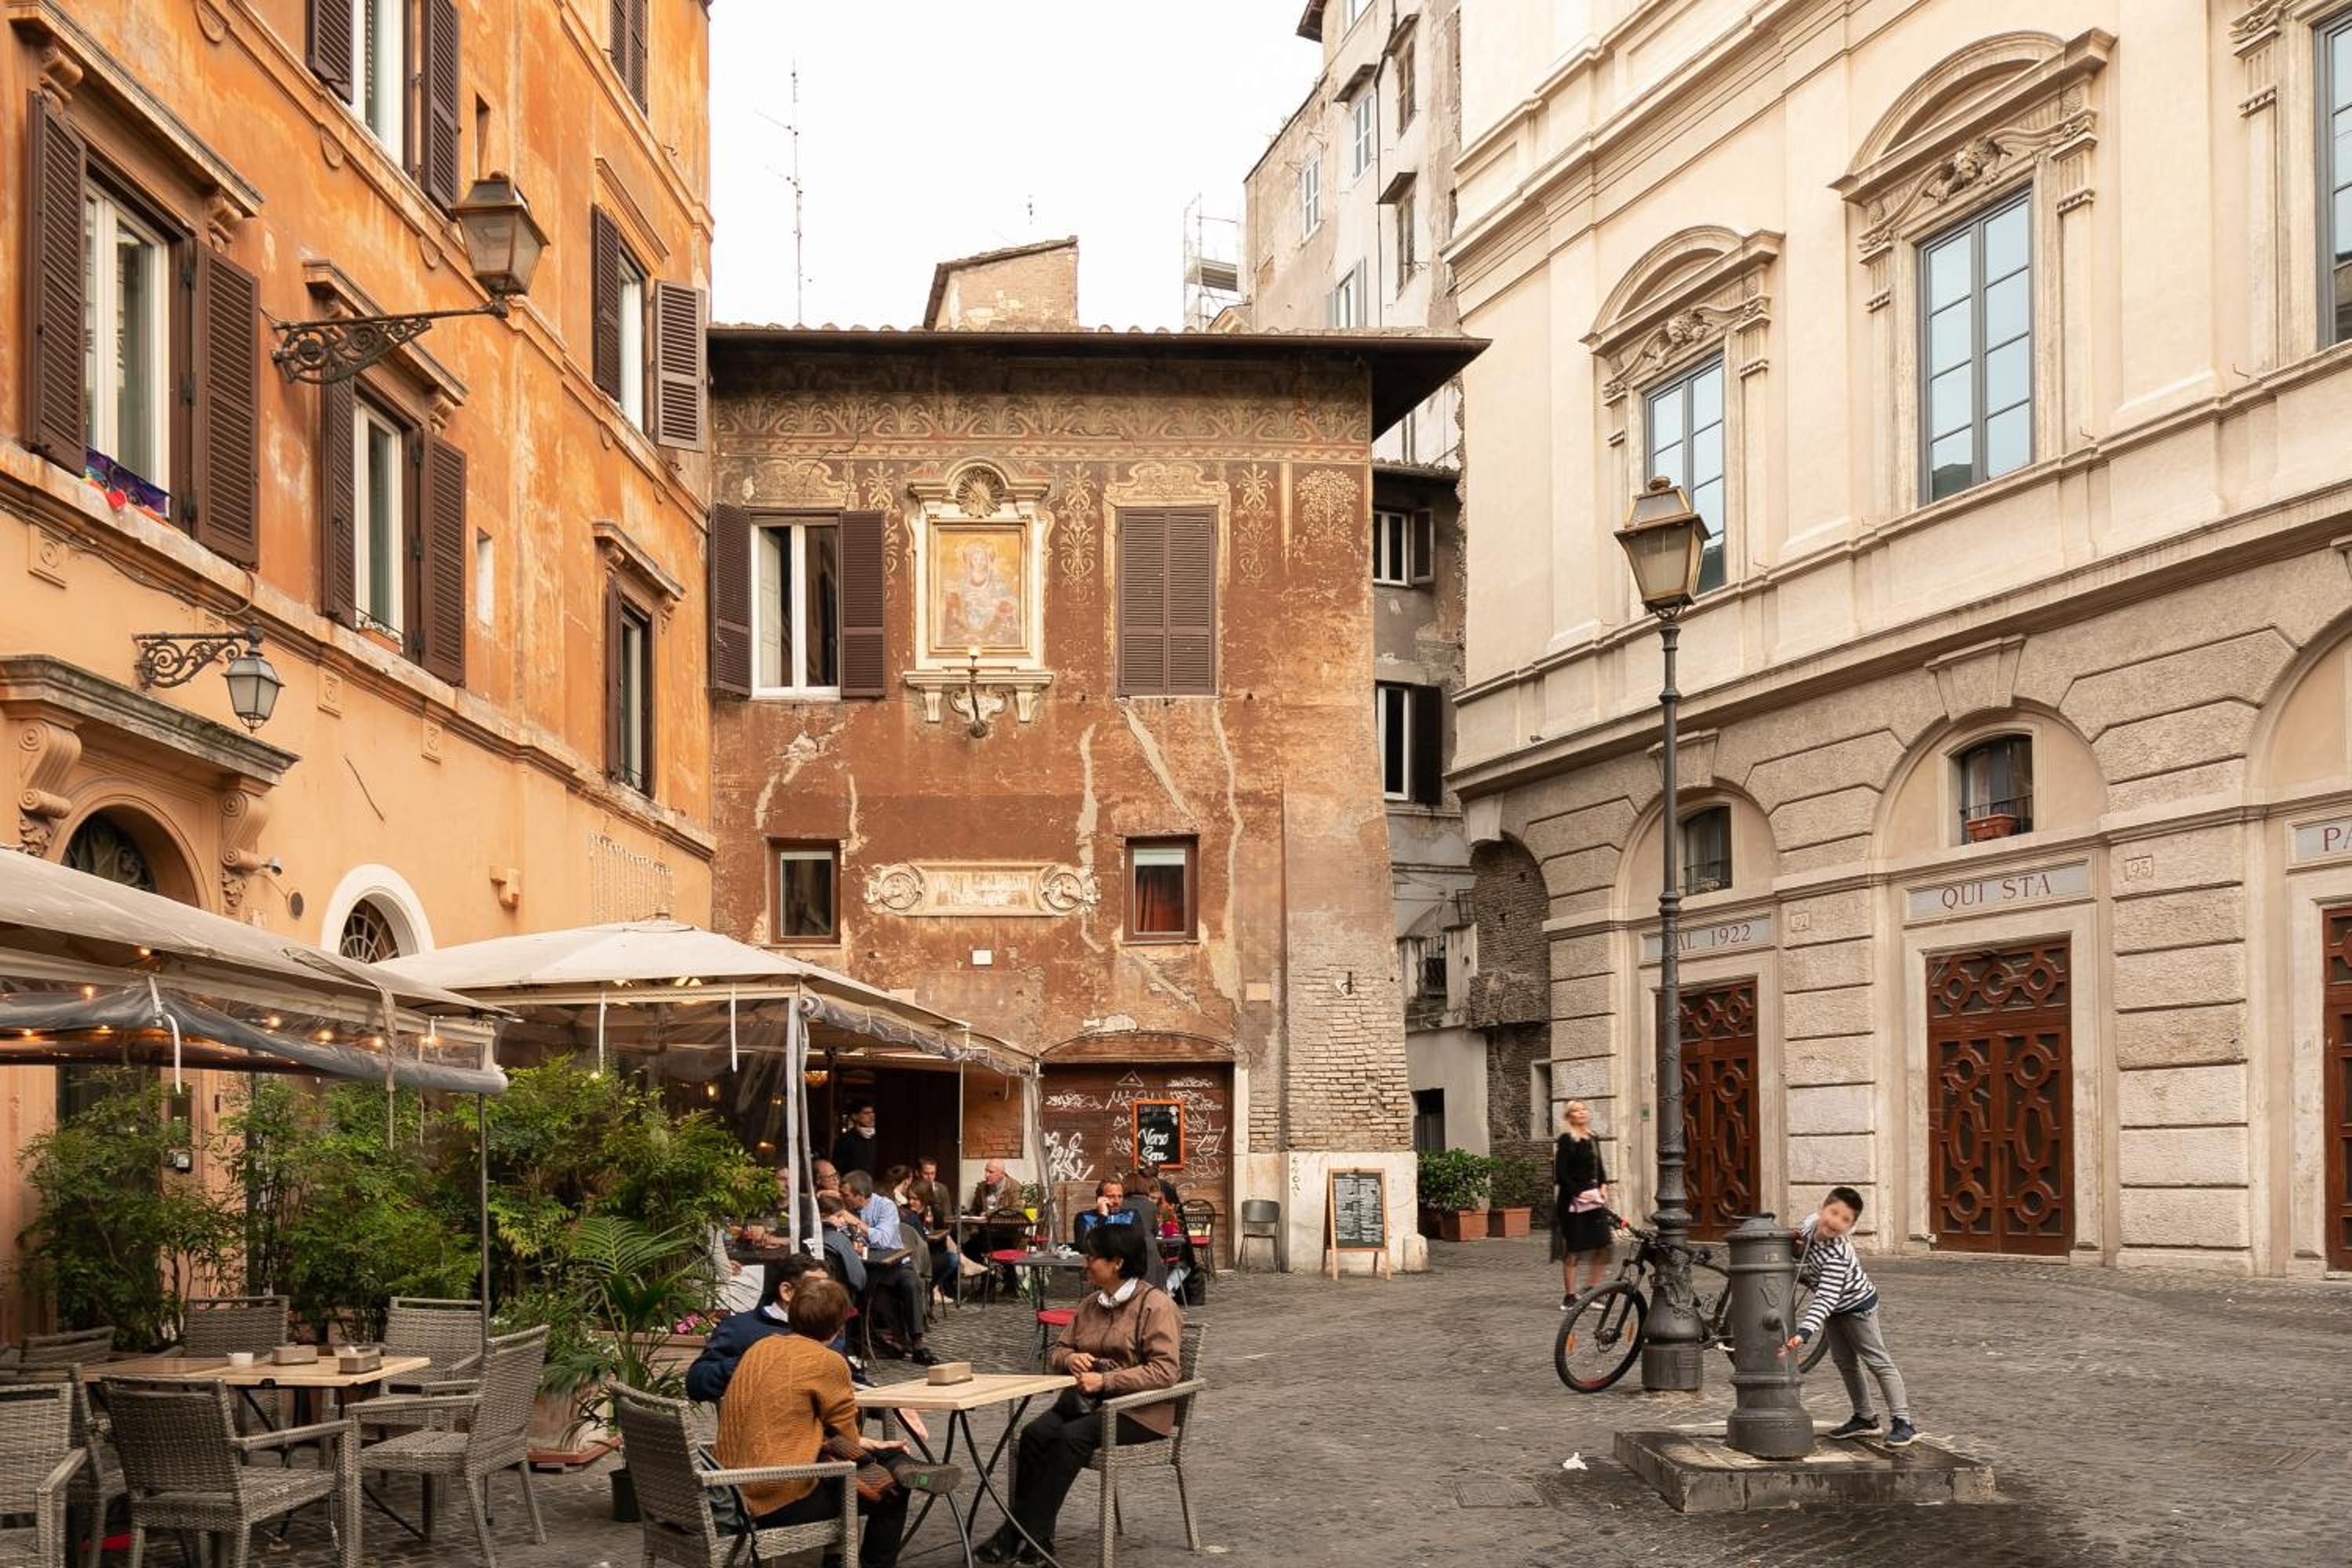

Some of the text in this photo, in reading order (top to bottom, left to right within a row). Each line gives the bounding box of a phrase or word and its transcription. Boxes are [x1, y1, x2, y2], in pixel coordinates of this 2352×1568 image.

[1941, 873, 2052, 909] QUI STA
[1709, 924, 1752, 947] 1922
